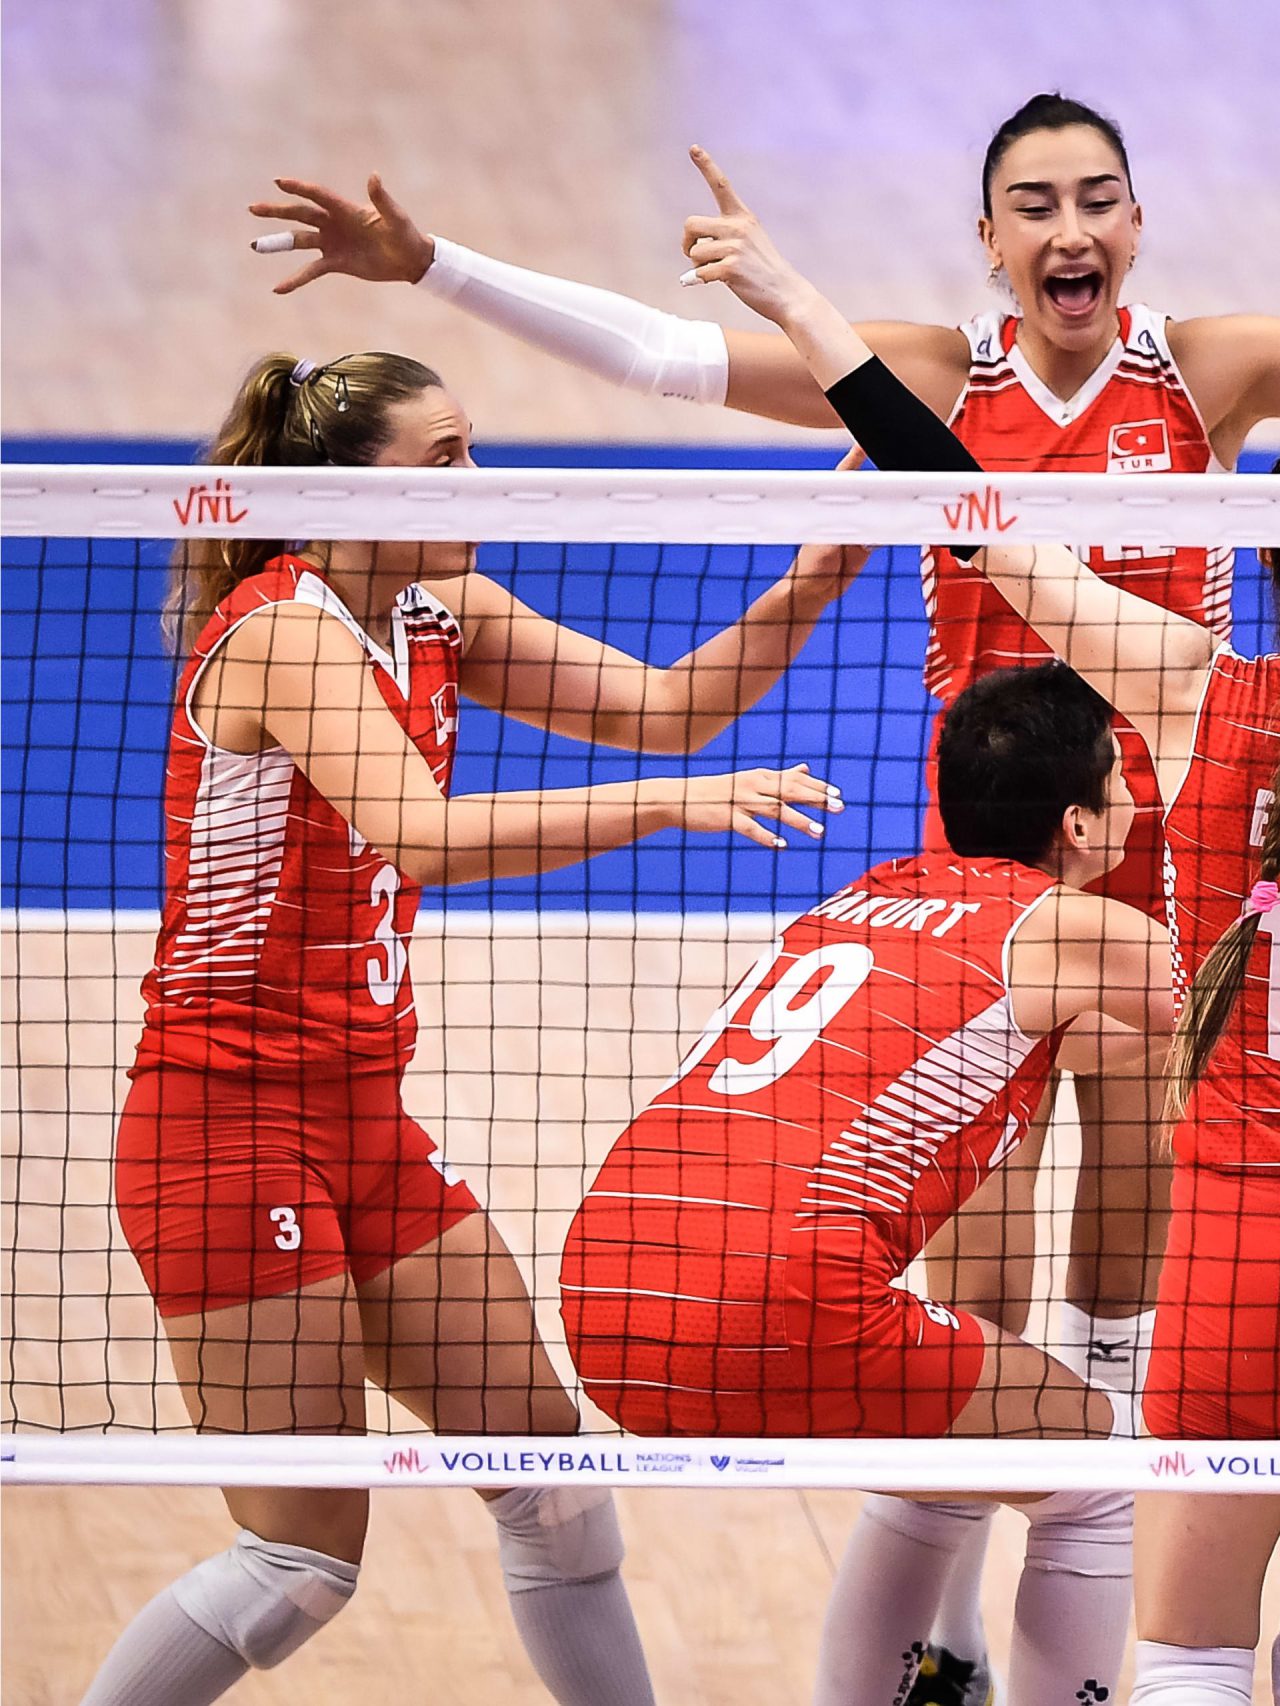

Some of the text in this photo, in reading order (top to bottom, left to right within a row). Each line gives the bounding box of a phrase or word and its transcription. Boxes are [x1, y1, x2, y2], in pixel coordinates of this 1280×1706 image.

[1119, 458, 1153, 470] TUR
[173, 478, 248, 526] VNL
[943, 485, 1018, 533] VNL
[367, 863, 408, 1006] 3
[269, 1206, 301, 1251] 3
[383, 1447, 630, 1473] VNL VOLLEYBALL
[636, 1453, 692, 1462] NATIONS
[1150, 1451, 1196, 1477] VNL
